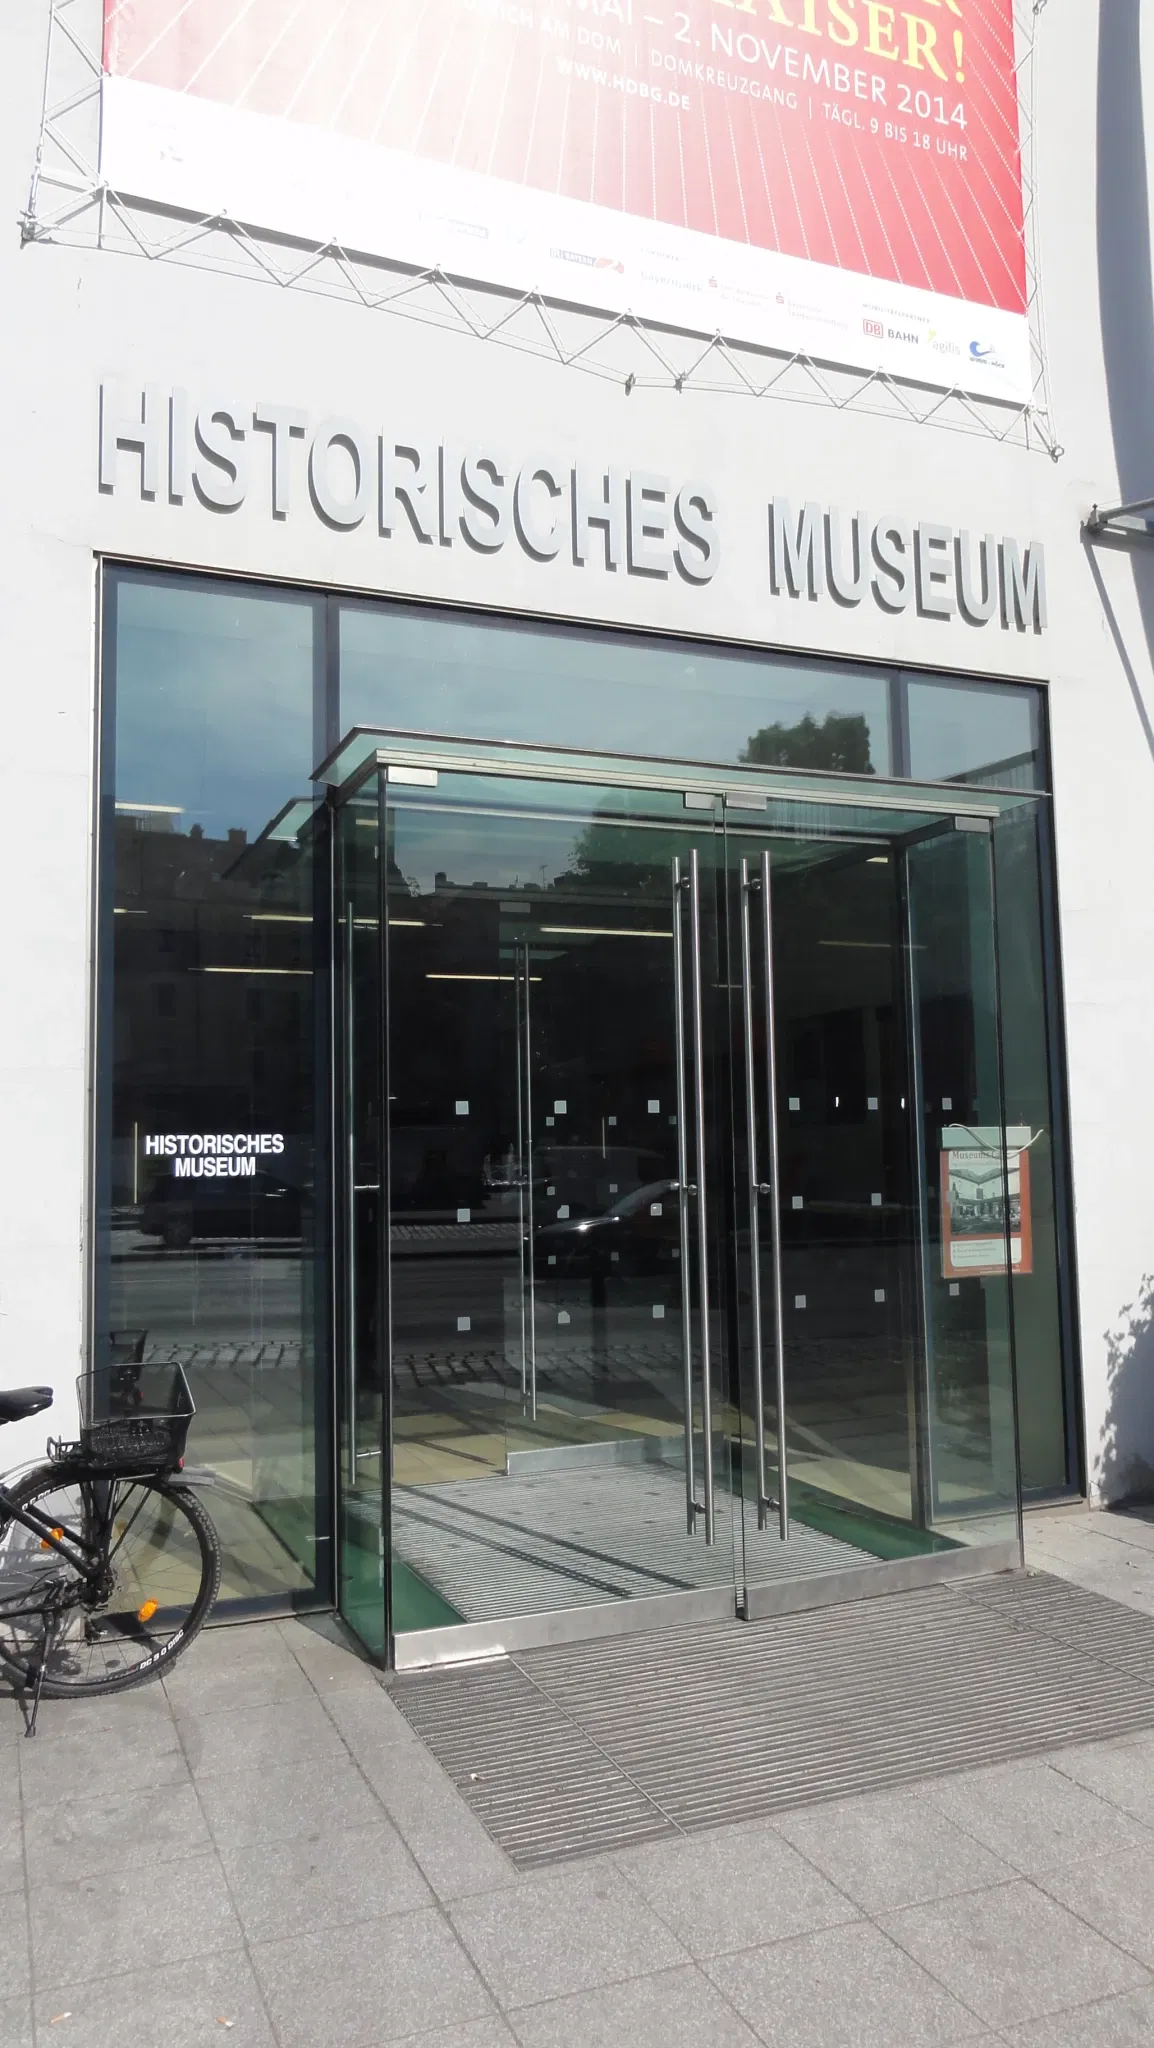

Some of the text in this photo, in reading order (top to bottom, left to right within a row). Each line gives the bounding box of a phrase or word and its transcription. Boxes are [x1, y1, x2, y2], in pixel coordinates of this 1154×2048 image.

[556, 55, 691, 111] WWW.HDBG.DE
[577, 26, 622, 56] DOM
[650, 49, 798, 110] DOMKREUZGANG
[823, 101, 867, 132] TÄGL.
[870, 117, 880, 135] 9
[884, 121, 908, 143] BIS
[913, 130, 931, 151] 18
[935, 138, 968, 162] UHR
[674, 11, 701, 47] 2.
[711, 22, 888, 106] NOVEMBER
[897, 83, 968, 130] 2014
[865, 322, 919, 345] DB BAHN
[99, 374, 1048, 633] HISTORISCHES MUSEUM
[145, 1134, 284, 1155] HISTORISCHES
[174, 1156, 256, 1177] MUSEUM
